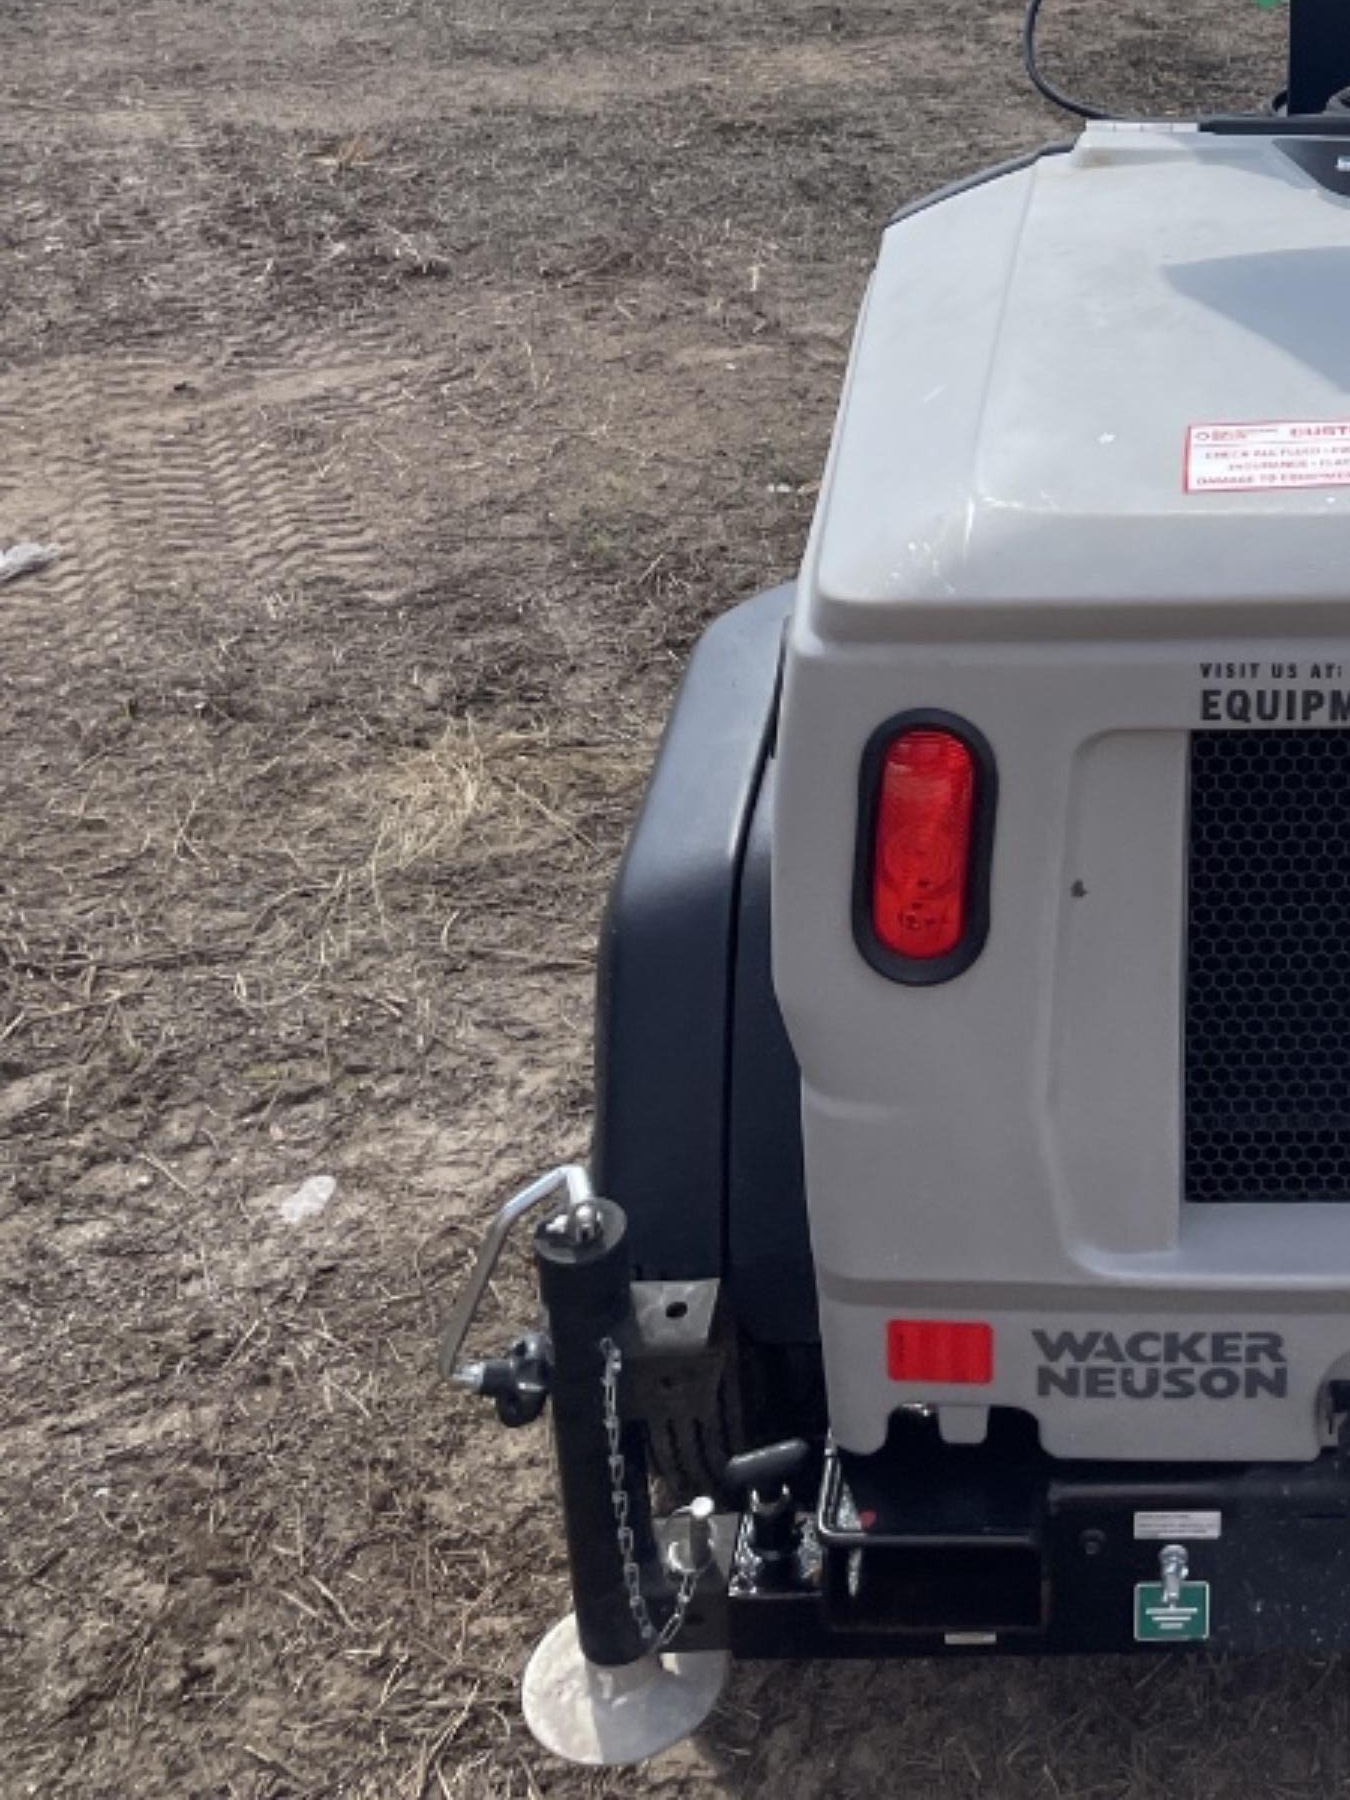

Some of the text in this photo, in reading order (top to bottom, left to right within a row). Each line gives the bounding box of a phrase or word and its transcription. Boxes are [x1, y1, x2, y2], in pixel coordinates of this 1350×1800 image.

[1200, 663, 1344, 679] VISIT US AT:
[1031, 1329, 1288, 1363] WACKER
[1037, 1366, 1288, 1399] NEUSON
